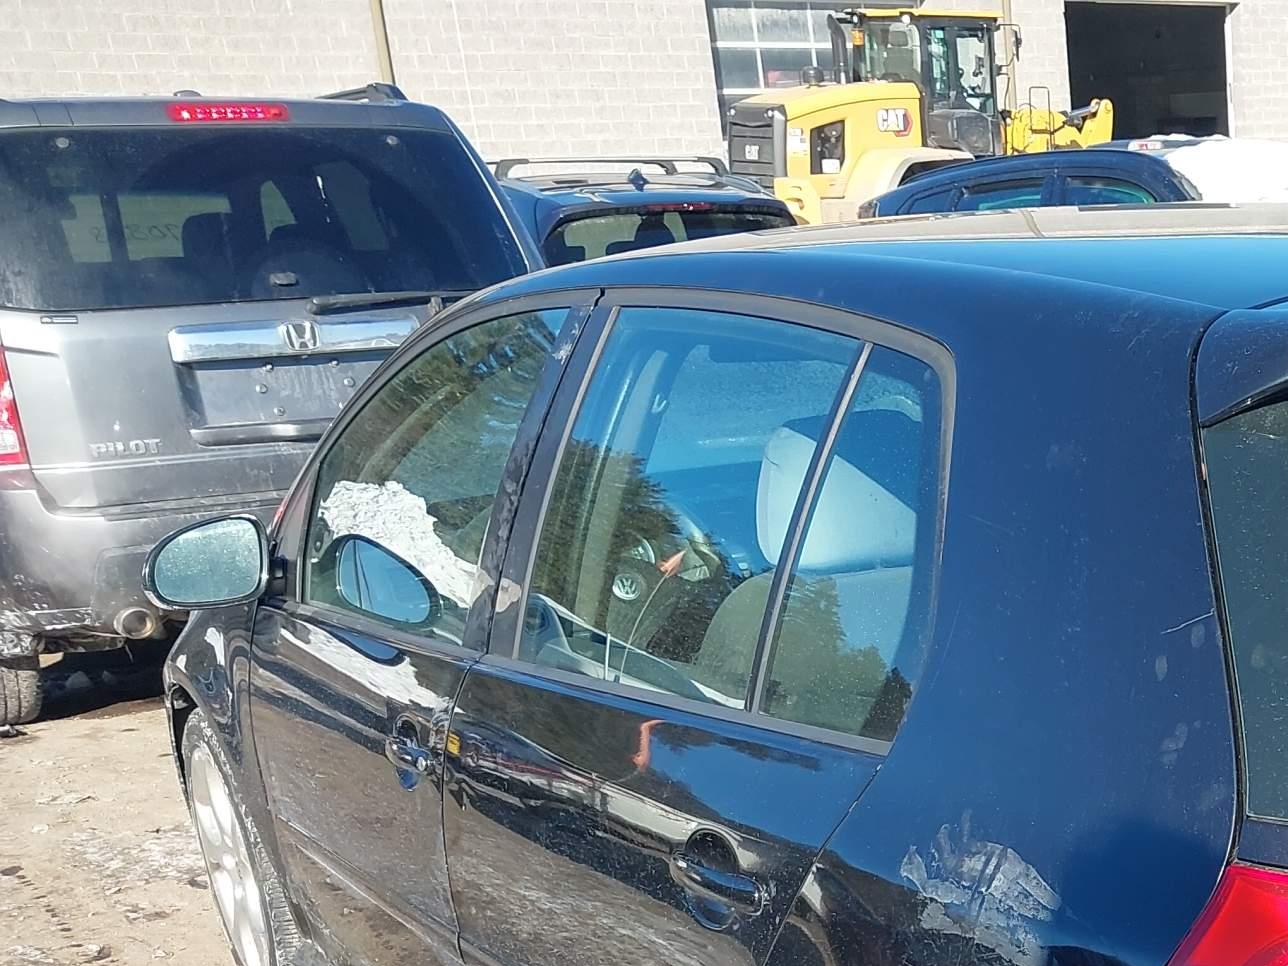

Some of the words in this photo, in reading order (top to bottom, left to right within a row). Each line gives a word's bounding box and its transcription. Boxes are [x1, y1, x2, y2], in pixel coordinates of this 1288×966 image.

[877, 108, 907, 132] CAT
[744, 144, 760, 160] CAT
[88, 438, 162, 458] PILOT
